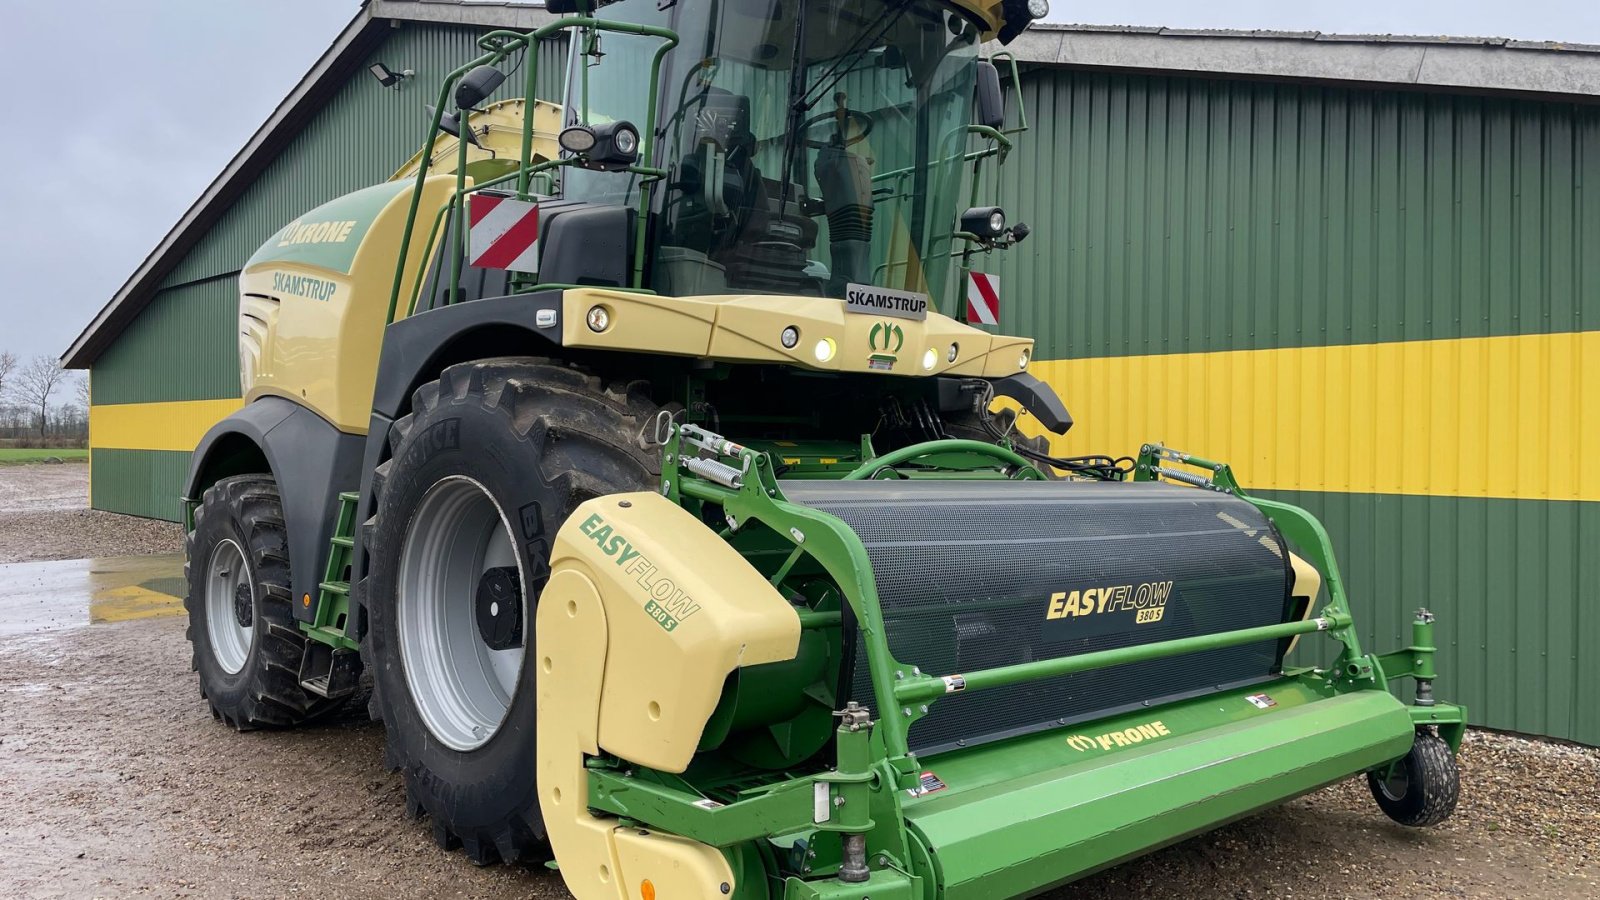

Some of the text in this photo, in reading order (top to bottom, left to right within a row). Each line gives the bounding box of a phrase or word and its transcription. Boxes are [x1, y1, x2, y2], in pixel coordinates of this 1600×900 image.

[290, 220, 357, 244] KRONE
[272, 271, 337, 302] SKAMSTRUP
[847, 290, 927, 314] SKAMSTRUP
[579, 512, 702, 622] EASYFLOW
[1046, 580, 1173, 620] EASYFLOW
[646, 603, 675, 629] 380 S
[1138, 609, 1161, 622] 380 S
[1094, 720, 1172, 751] KRONE
